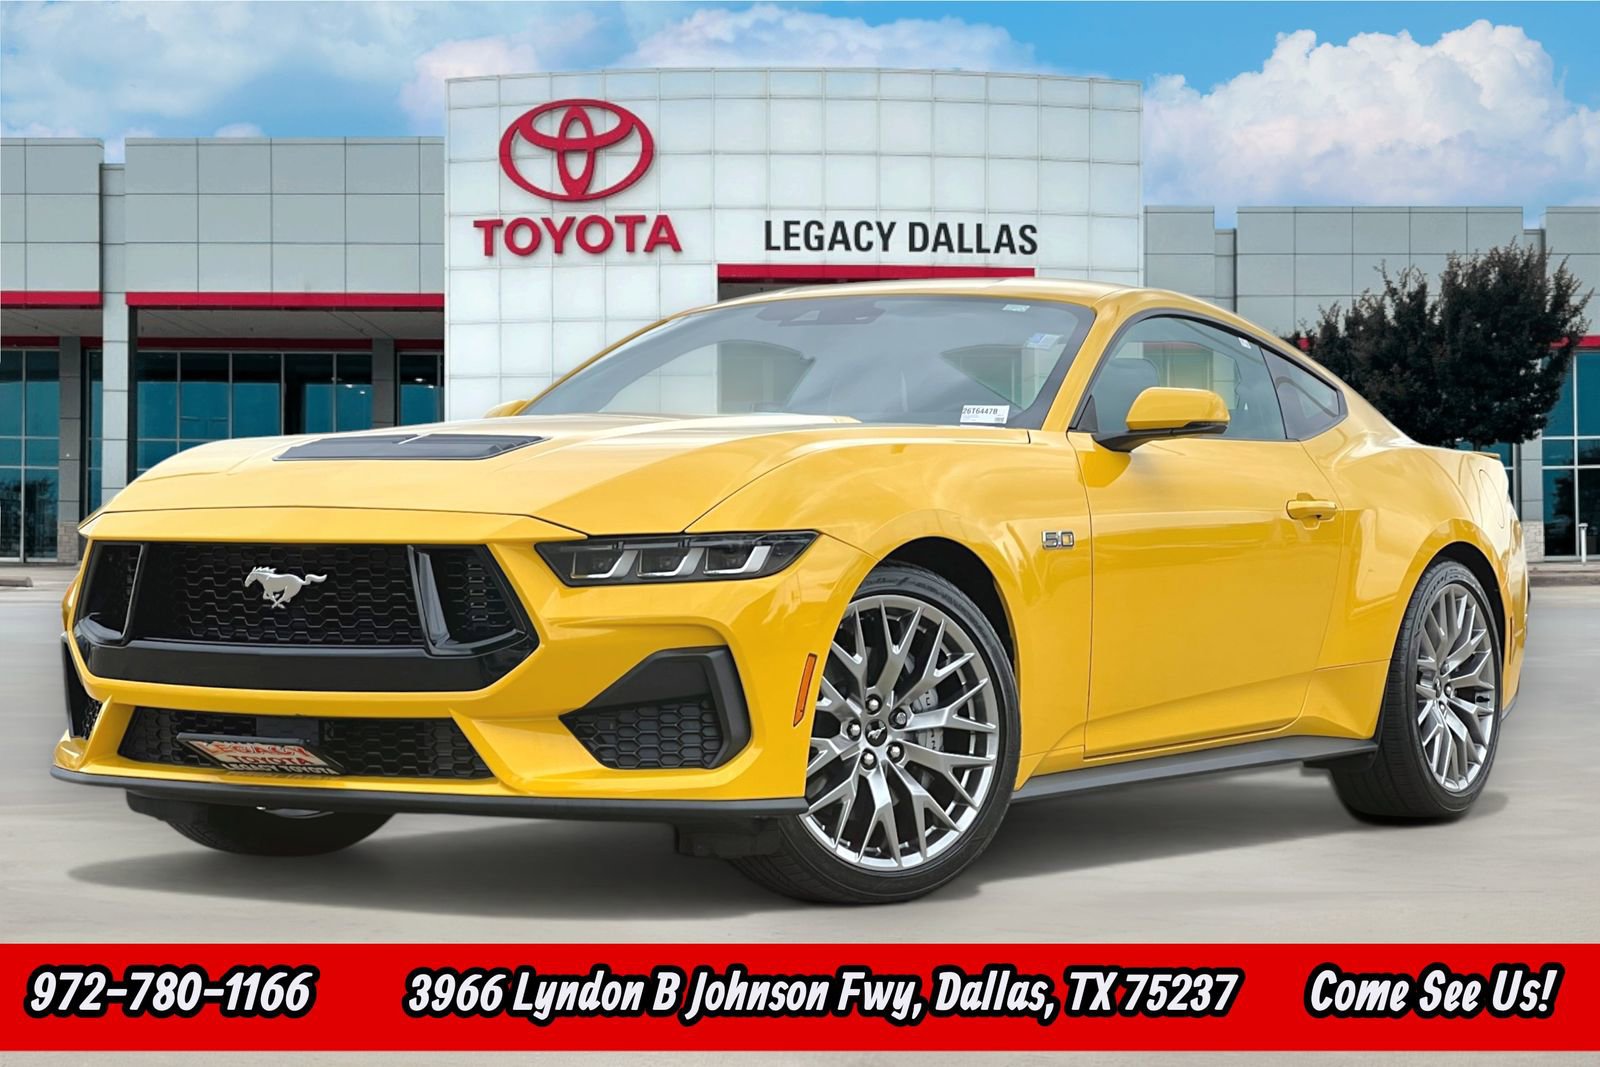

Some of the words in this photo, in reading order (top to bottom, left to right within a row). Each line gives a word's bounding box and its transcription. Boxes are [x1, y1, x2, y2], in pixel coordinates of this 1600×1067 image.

[473, 214, 683, 257] TOYOTA
[765, 220, 897, 252] LEGACY
[908, 221, 1038, 255] DALLAS
[221, 763, 280, 772] LEGACY
[279, 765, 341, 775] TOYOTA
[227, 755, 314, 766] TOYOTA
